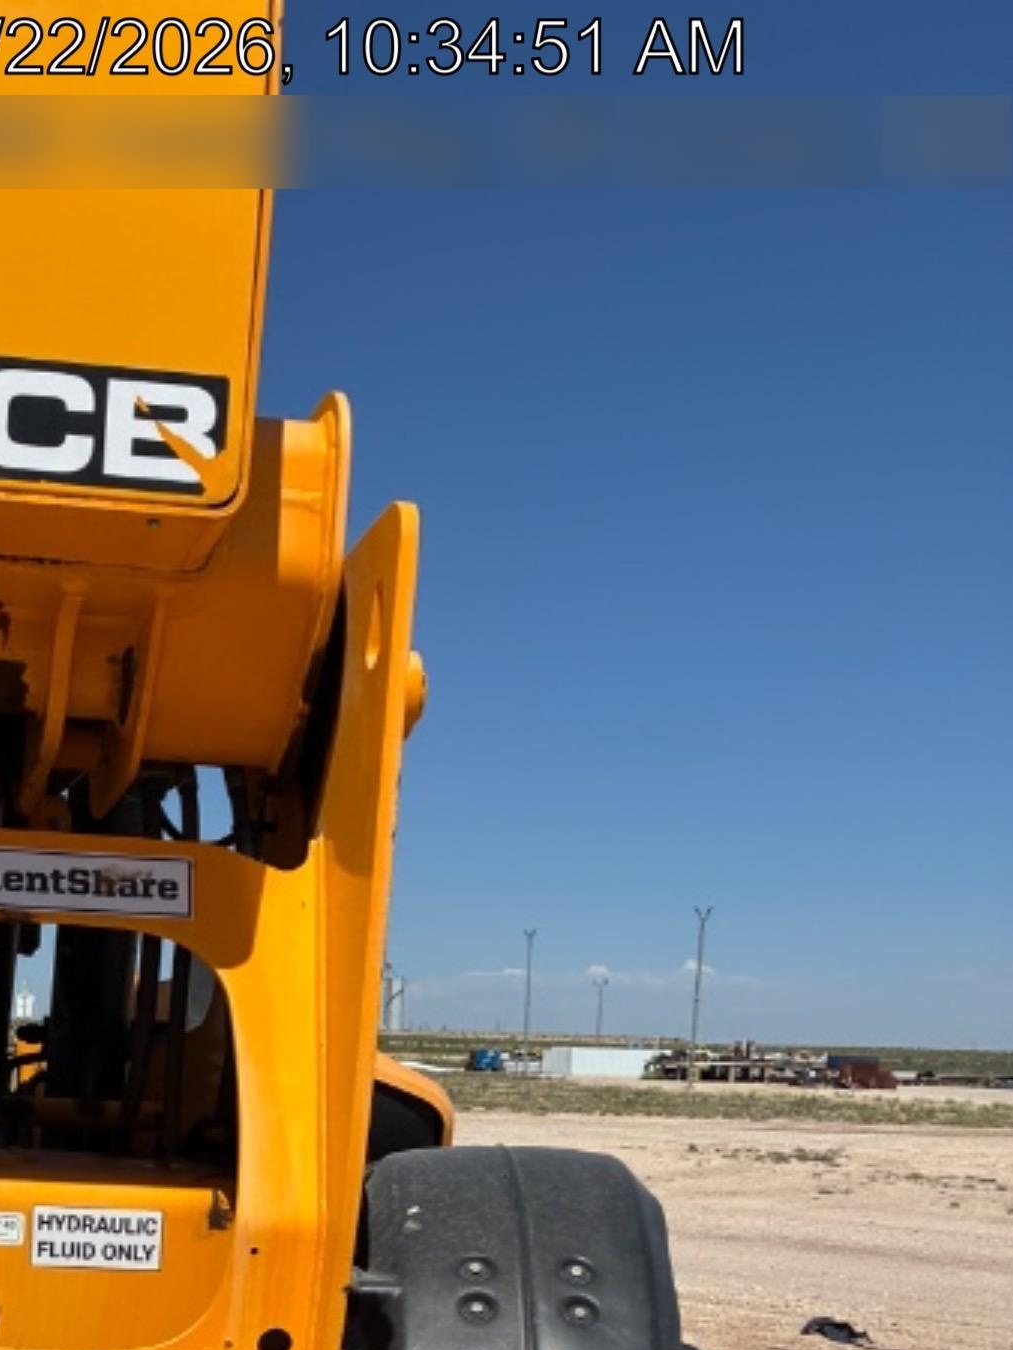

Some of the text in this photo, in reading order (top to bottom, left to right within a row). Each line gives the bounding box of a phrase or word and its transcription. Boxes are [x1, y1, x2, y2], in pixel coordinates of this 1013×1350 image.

[37, 1213, 158, 1237] HYDRAULIC
[37, 1240, 156, 1262] FLUID ONLY
